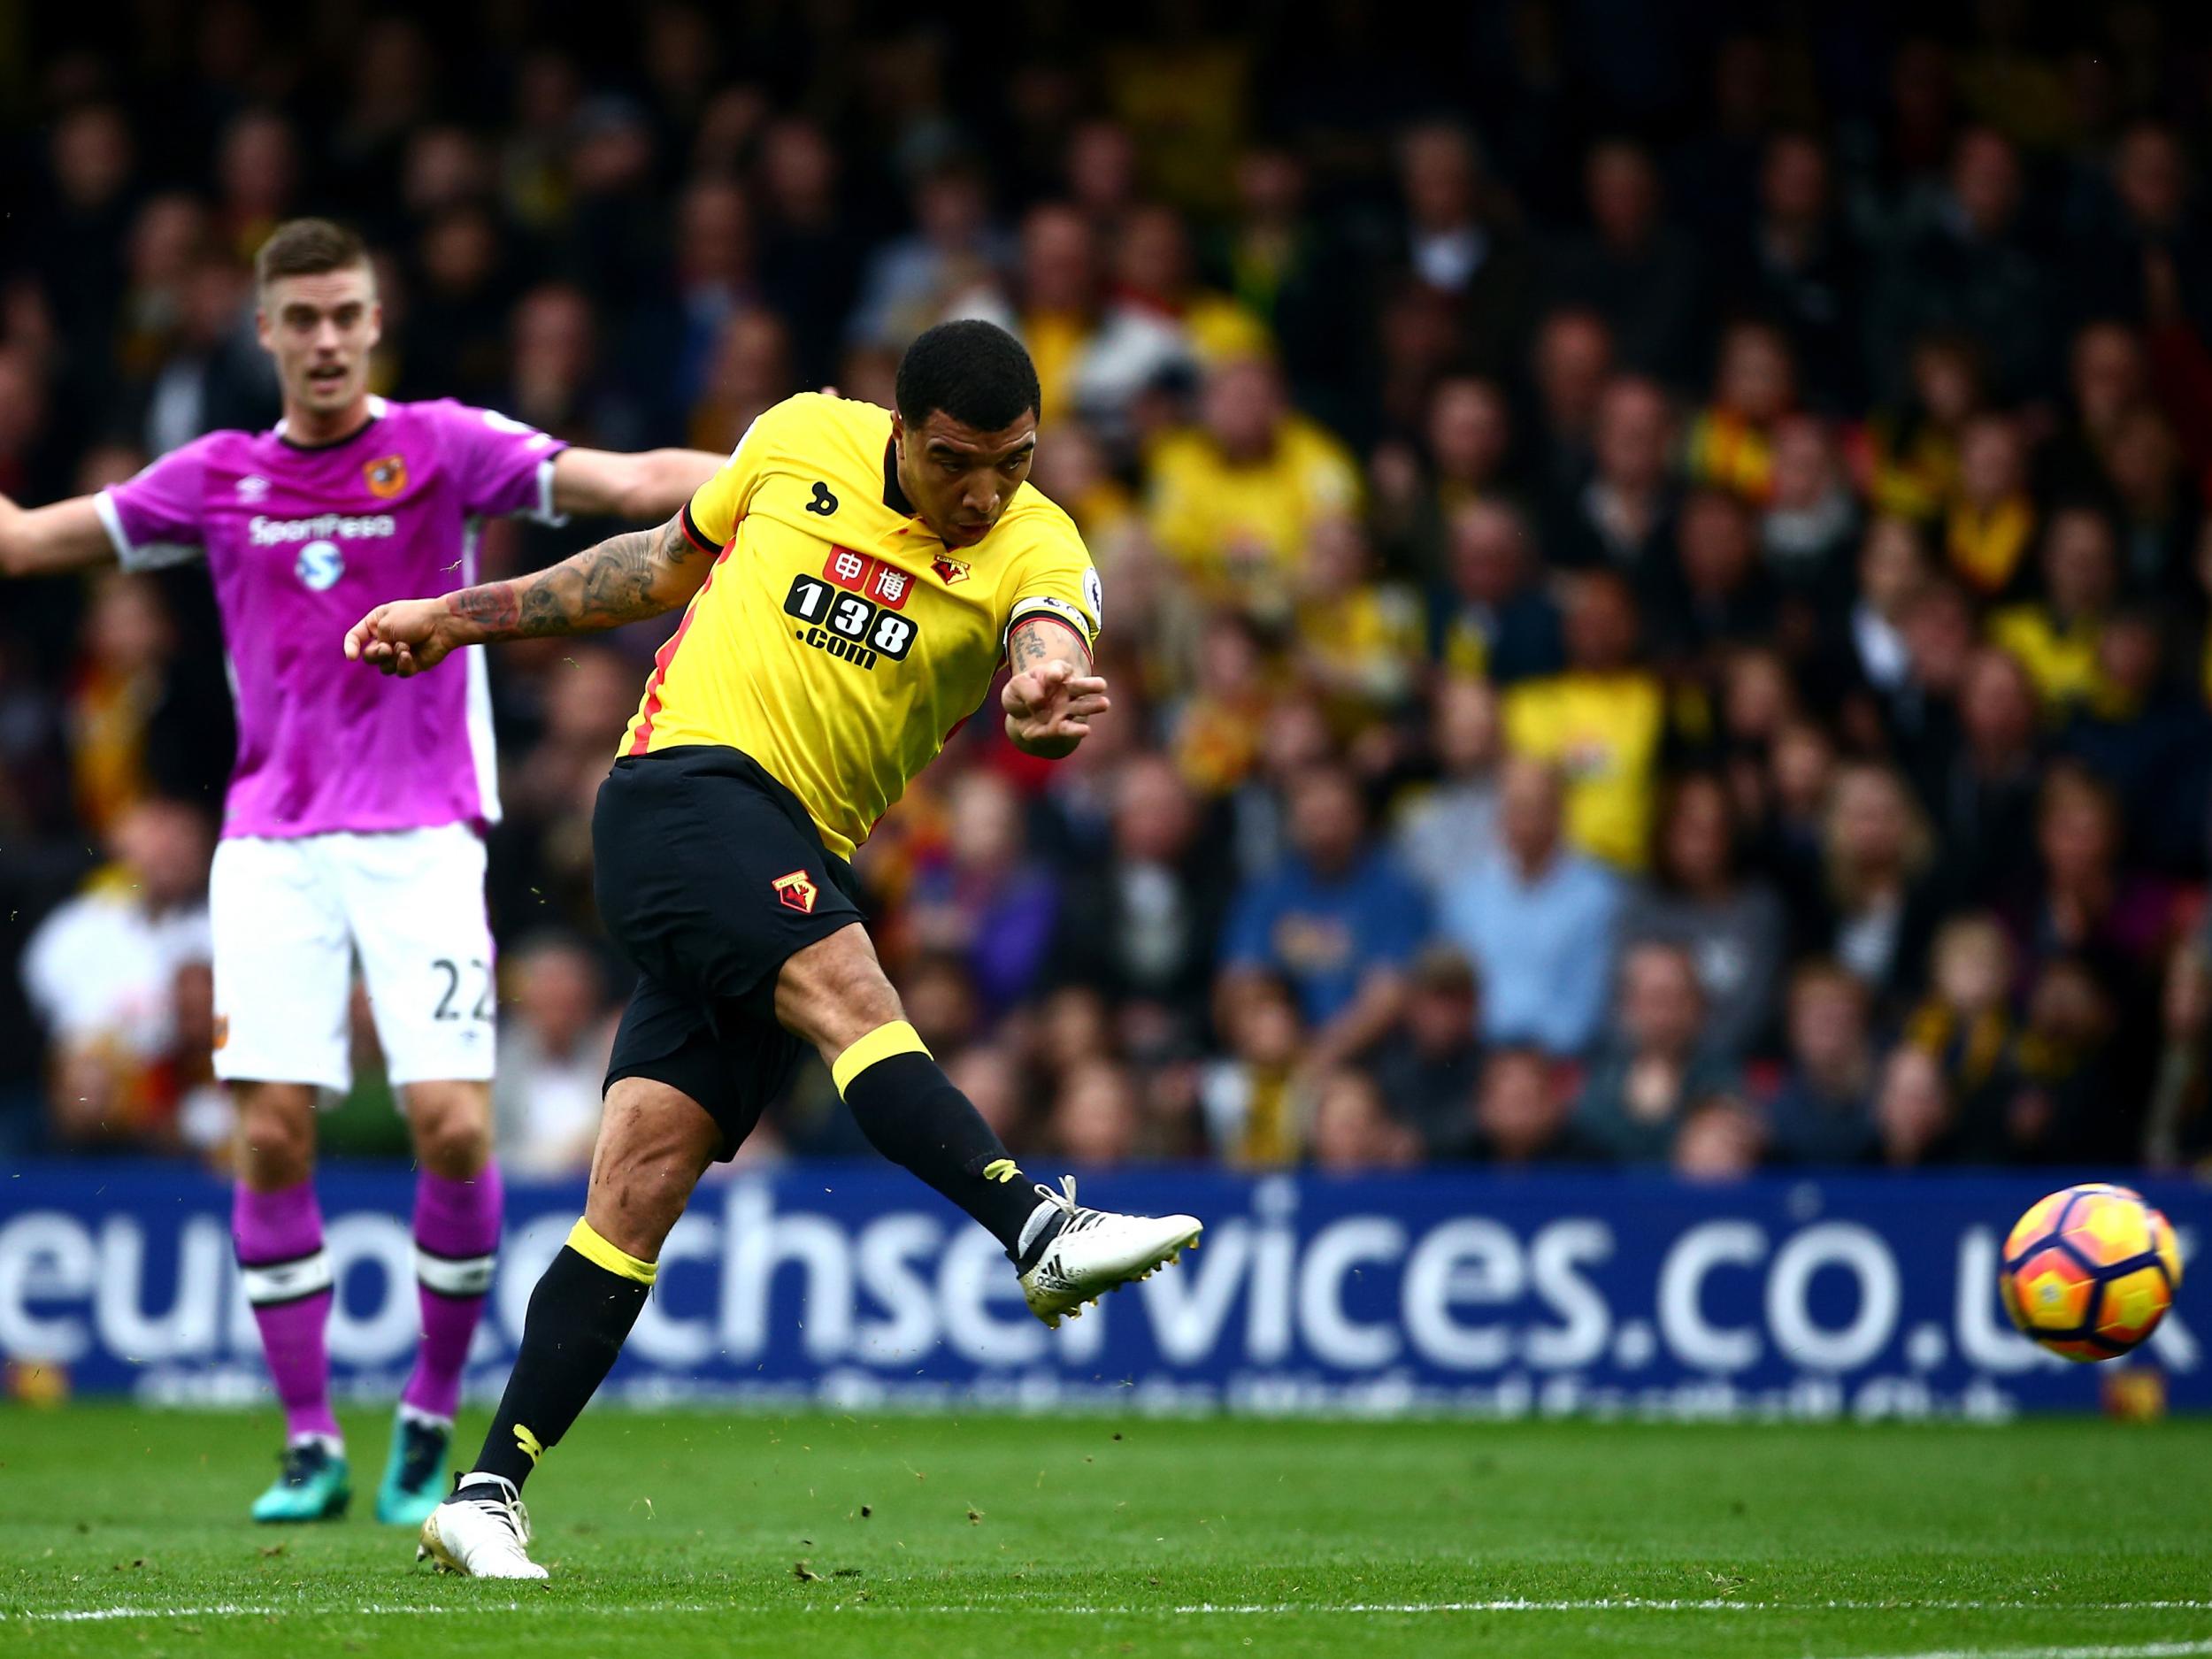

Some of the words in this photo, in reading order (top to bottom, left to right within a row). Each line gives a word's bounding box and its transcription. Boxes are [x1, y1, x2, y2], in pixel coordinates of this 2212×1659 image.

[249, 513, 396, 548] SportPesa
[834, 553, 909, 603] 申博
[797, 582, 910, 655] 138
[795, 627, 878, 671] .com
